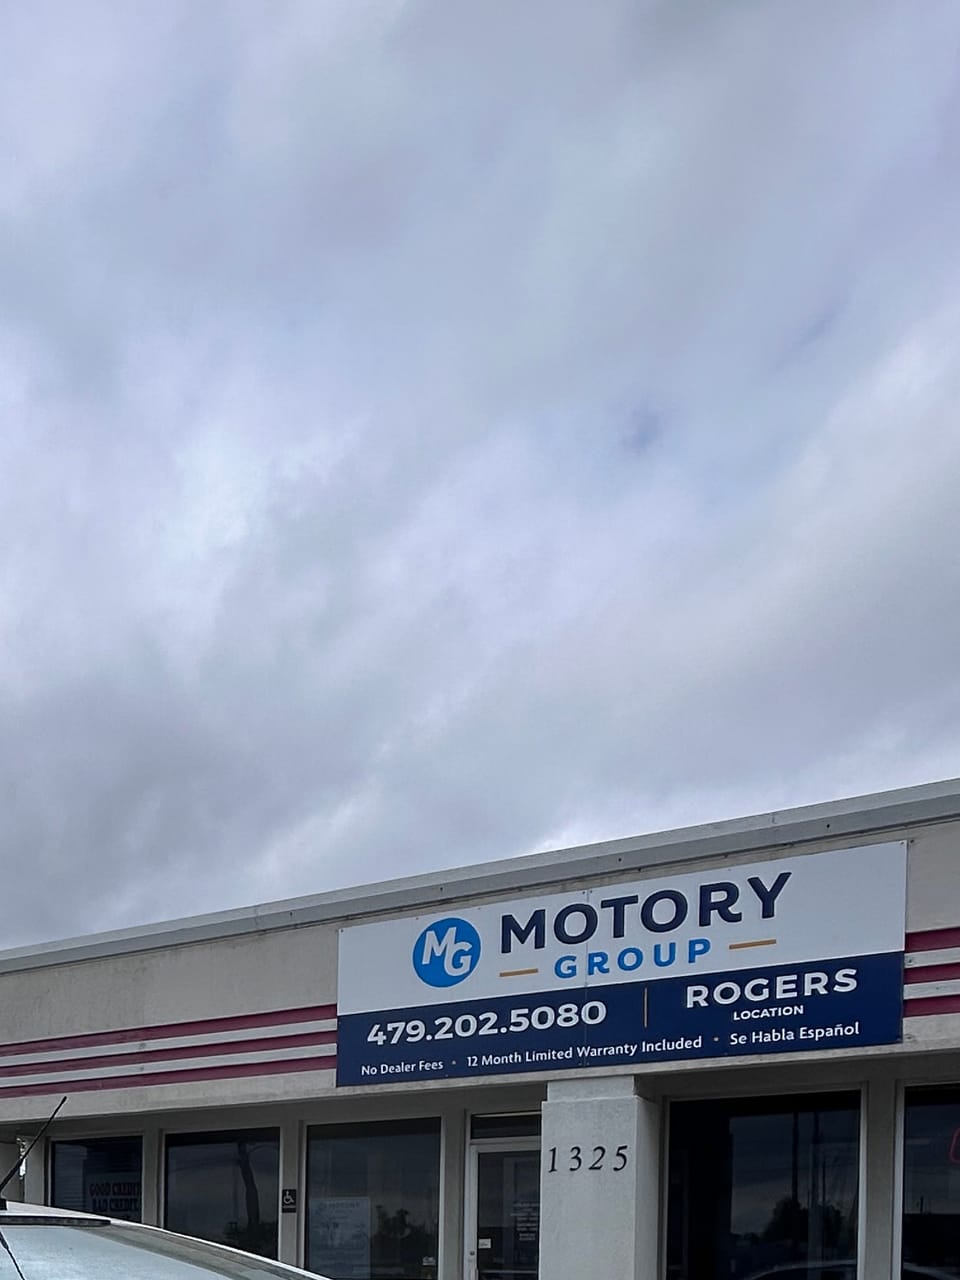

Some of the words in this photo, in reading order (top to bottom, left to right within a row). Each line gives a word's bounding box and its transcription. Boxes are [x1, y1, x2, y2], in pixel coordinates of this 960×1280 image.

[500, 871, 793, 955] MOTORY
[421, 926, 472, 977] MG
[554, 938, 711, 979] GROUP
[686, 968, 858, 1009] ROGERS
[366, 1000, 607, 1045] 479.202.5080
[733, 1004, 804, 1021] LOCATION
[361, 1065, 378, 1076] No
[380, 1061, 418, 1075] Dealer
[419, 1059, 444, 1072] Fees
[466, 1055, 479, 1067] 12
[481, 1052, 522, 1066] Month
[525, 1047, 573, 1062] Limited
[577, 1042, 638, 1058] Warranty
[641, 1036, 702, 1053] Included
[729, 1032, 749, 1045] Se
[751, 1028, 795, 1043] Habla
[799, 1021, 860, 1040] Español
[548, 1145, 629, 1174] 1325
